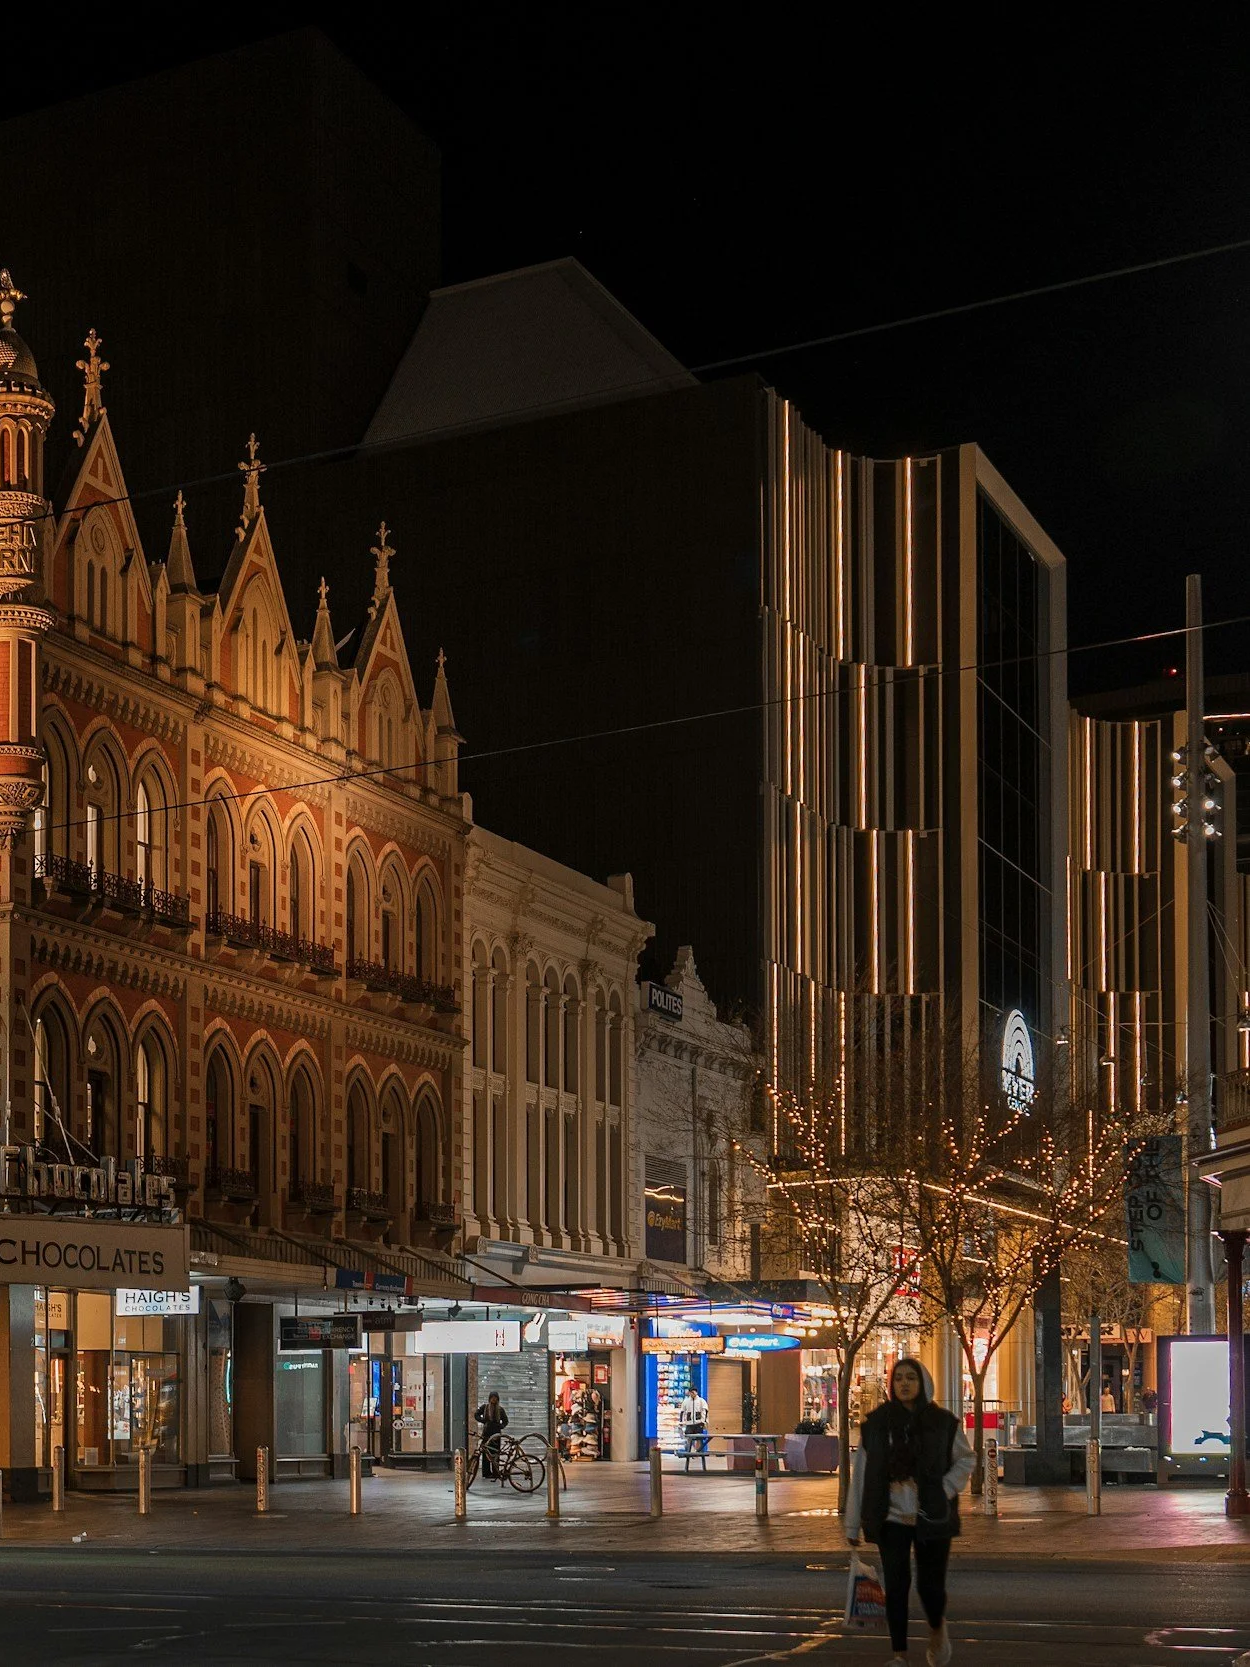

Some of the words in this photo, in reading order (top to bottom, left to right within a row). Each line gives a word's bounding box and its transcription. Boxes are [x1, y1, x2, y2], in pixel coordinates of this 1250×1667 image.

[652, 987, 682, 1015] POLITES
[1146, 1190, 1163, 1220] OF
[1128, 1195, 1144, 1252] STEP
[125, 1292, 191, 1303] HAIGH'S
[521, 1292, 539, 1304] GONG
[539, 1294, 550, 1306] CHA
[35, 1303, 62, 1312] HAGH'S
[374, 1316, 391, 1325] atm
